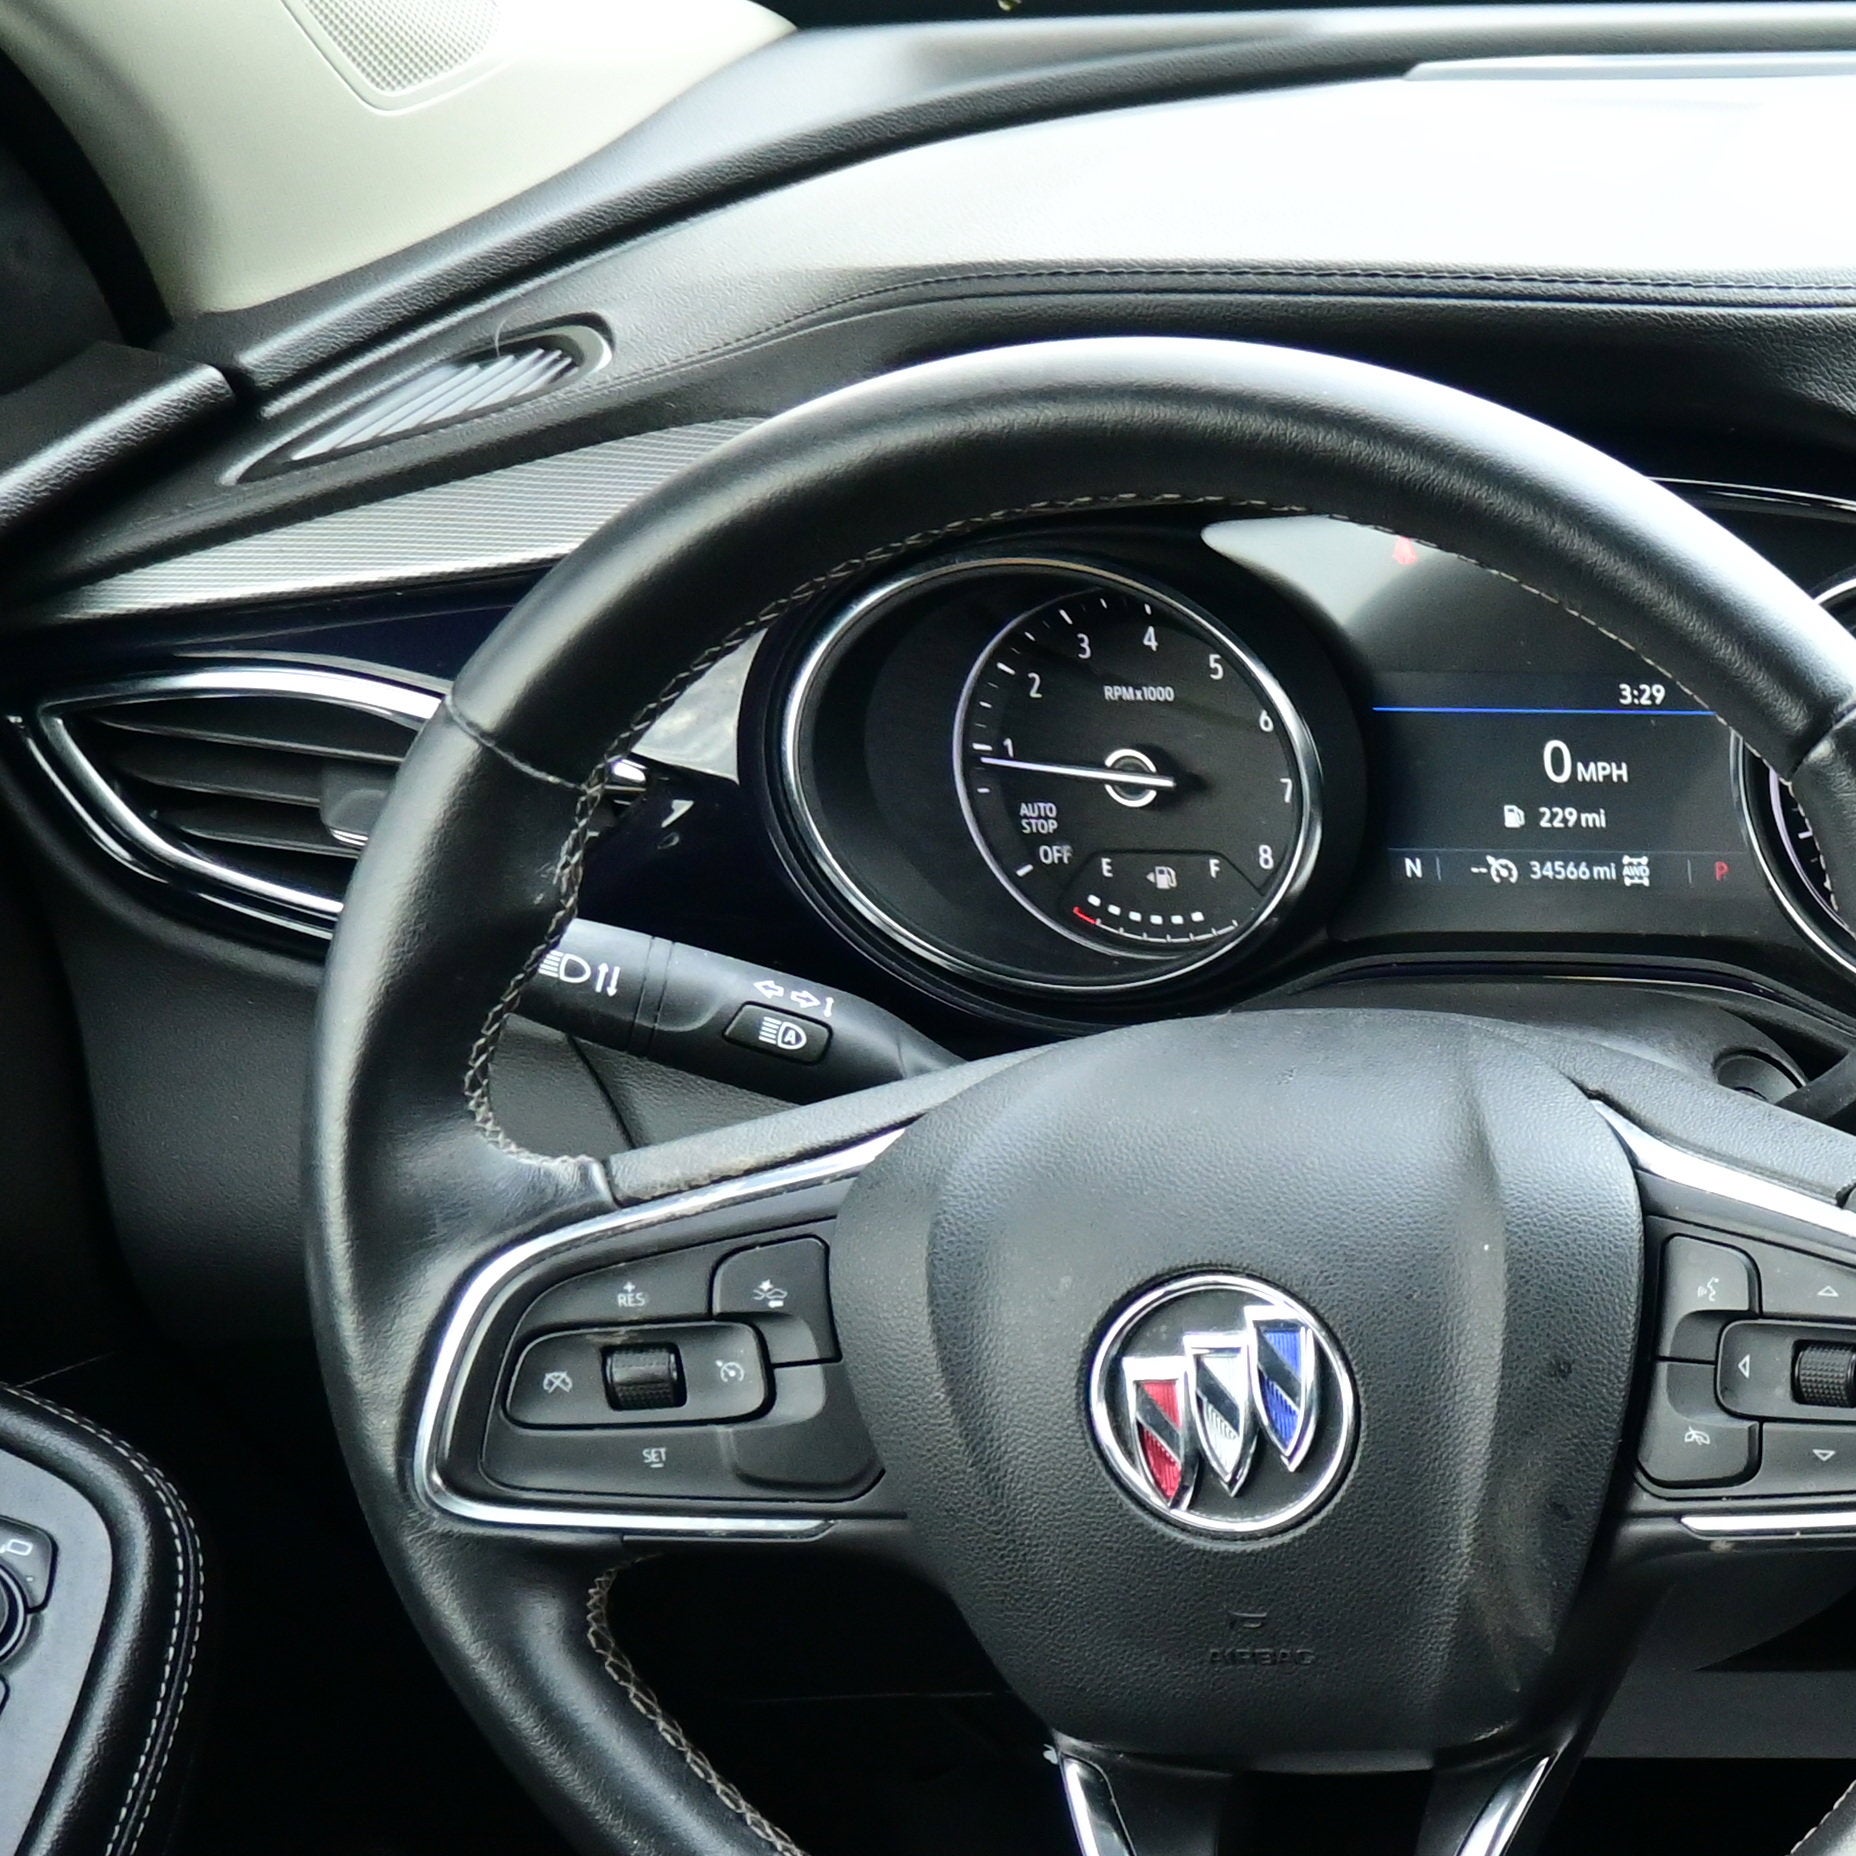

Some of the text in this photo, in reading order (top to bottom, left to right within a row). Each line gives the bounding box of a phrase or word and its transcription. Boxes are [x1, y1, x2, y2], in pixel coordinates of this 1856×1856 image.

[1078, 635, 1091, 659] 3
[1143, 627, 1158, 651] 4
[1209, 655, 1223, 679] 5
[1029, 673, 1042, 698] 2
[1619, 683, 1666, 706] 3:29
[1259, 710, 1274, 732] 6
[1005, 738, 1014, 758] 1
[1543, 740, 1628, 783] 0 MPH
[1280, 778, 1293, 803] 7
[1019, 802, 1056, 818] AUTO
[1539, 807, 1606, 828] 229 mi
[1022, 817, 1058, 834] STOP
[1039, 845, 1072, 864] OFF
[1259, 845, 1274, 870] 8
[1101, 858, 1112, 878] E
[1210, 858, 1220, 878] F
[1404, 858, 1422, 878] N
[1529, 861, 1616, 880] 34566 mi
[1714, 861, 1729, 881] P
[617, 1293, 645, 1308] RES
[643, 1448, 666, 1462] SET
